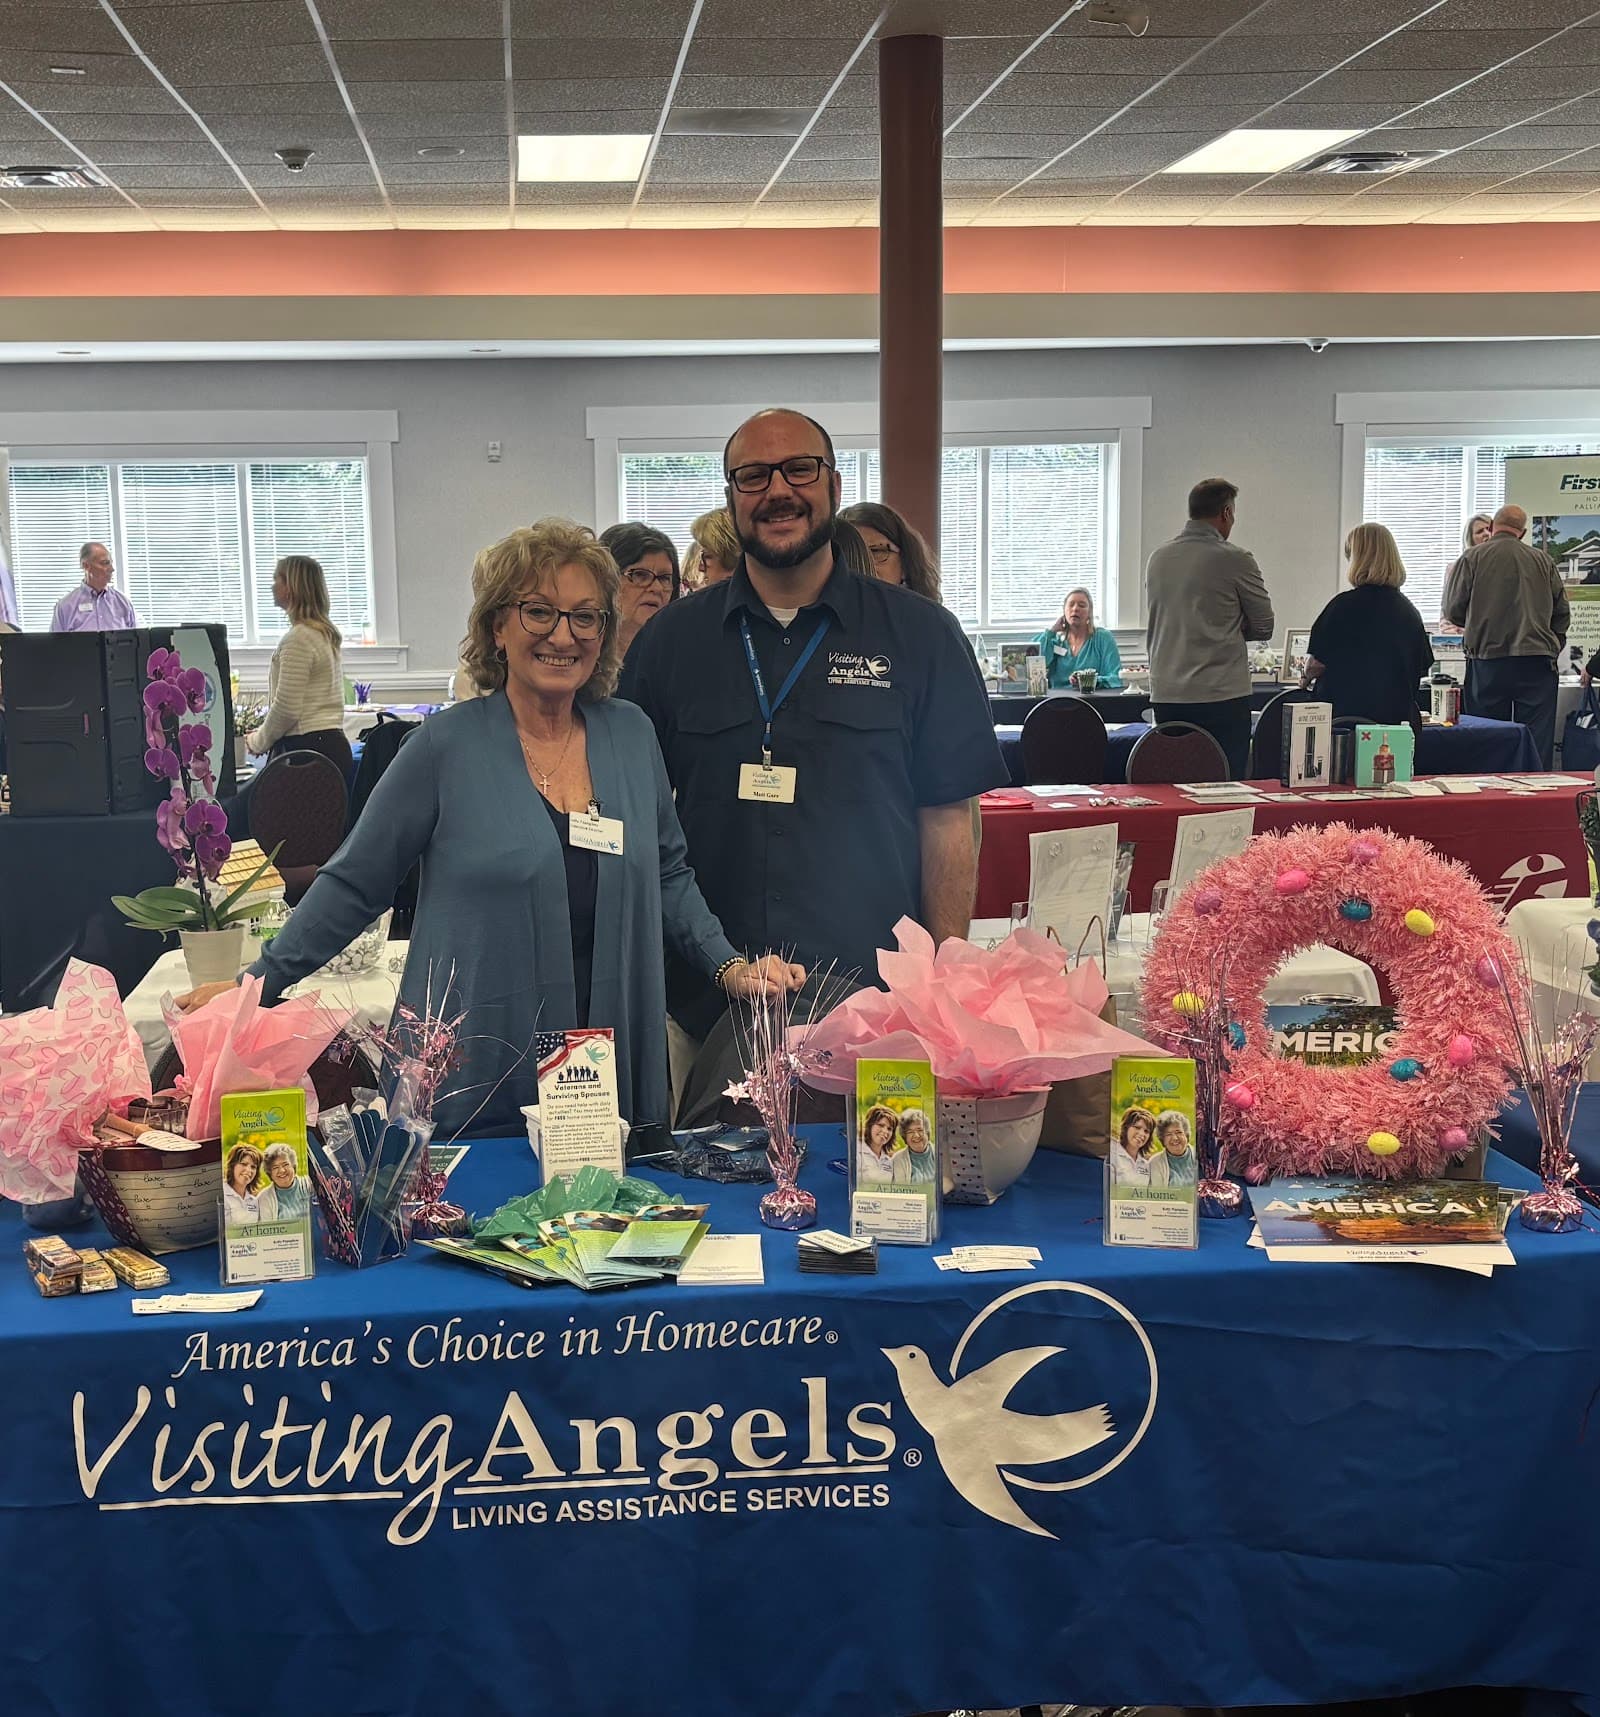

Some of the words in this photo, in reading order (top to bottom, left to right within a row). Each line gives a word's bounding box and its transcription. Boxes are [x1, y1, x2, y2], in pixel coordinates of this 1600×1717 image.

[1560, 474, 1600, 490] Firs
[828, 652, 864, 669] Visiting
[828, 666, 872, 678] Angels
[1267, 1023, 1385, 1031] ANDSCAPES
[1272, 1030, 1398, 1052] MERIC
[546, 1092, 579, 1100] Surviving
[580, 1091, 610, 1099] Spouses
[1131, 1188, 1144, 1198] At
[241, 1226, 253, 1237] At
[171, 1319, 393, 1379] America's
[407, 1316, 545, 1369] Choice
[560, 1315, 602, 1357] in
[72, 1380, 474, 1546] Visiting
[452, 1501, 548, 1530] LIVING
[556, 1489, 738, 1522] ASSISTANCE
[746, 1483, 890, 1513] SERVICES
